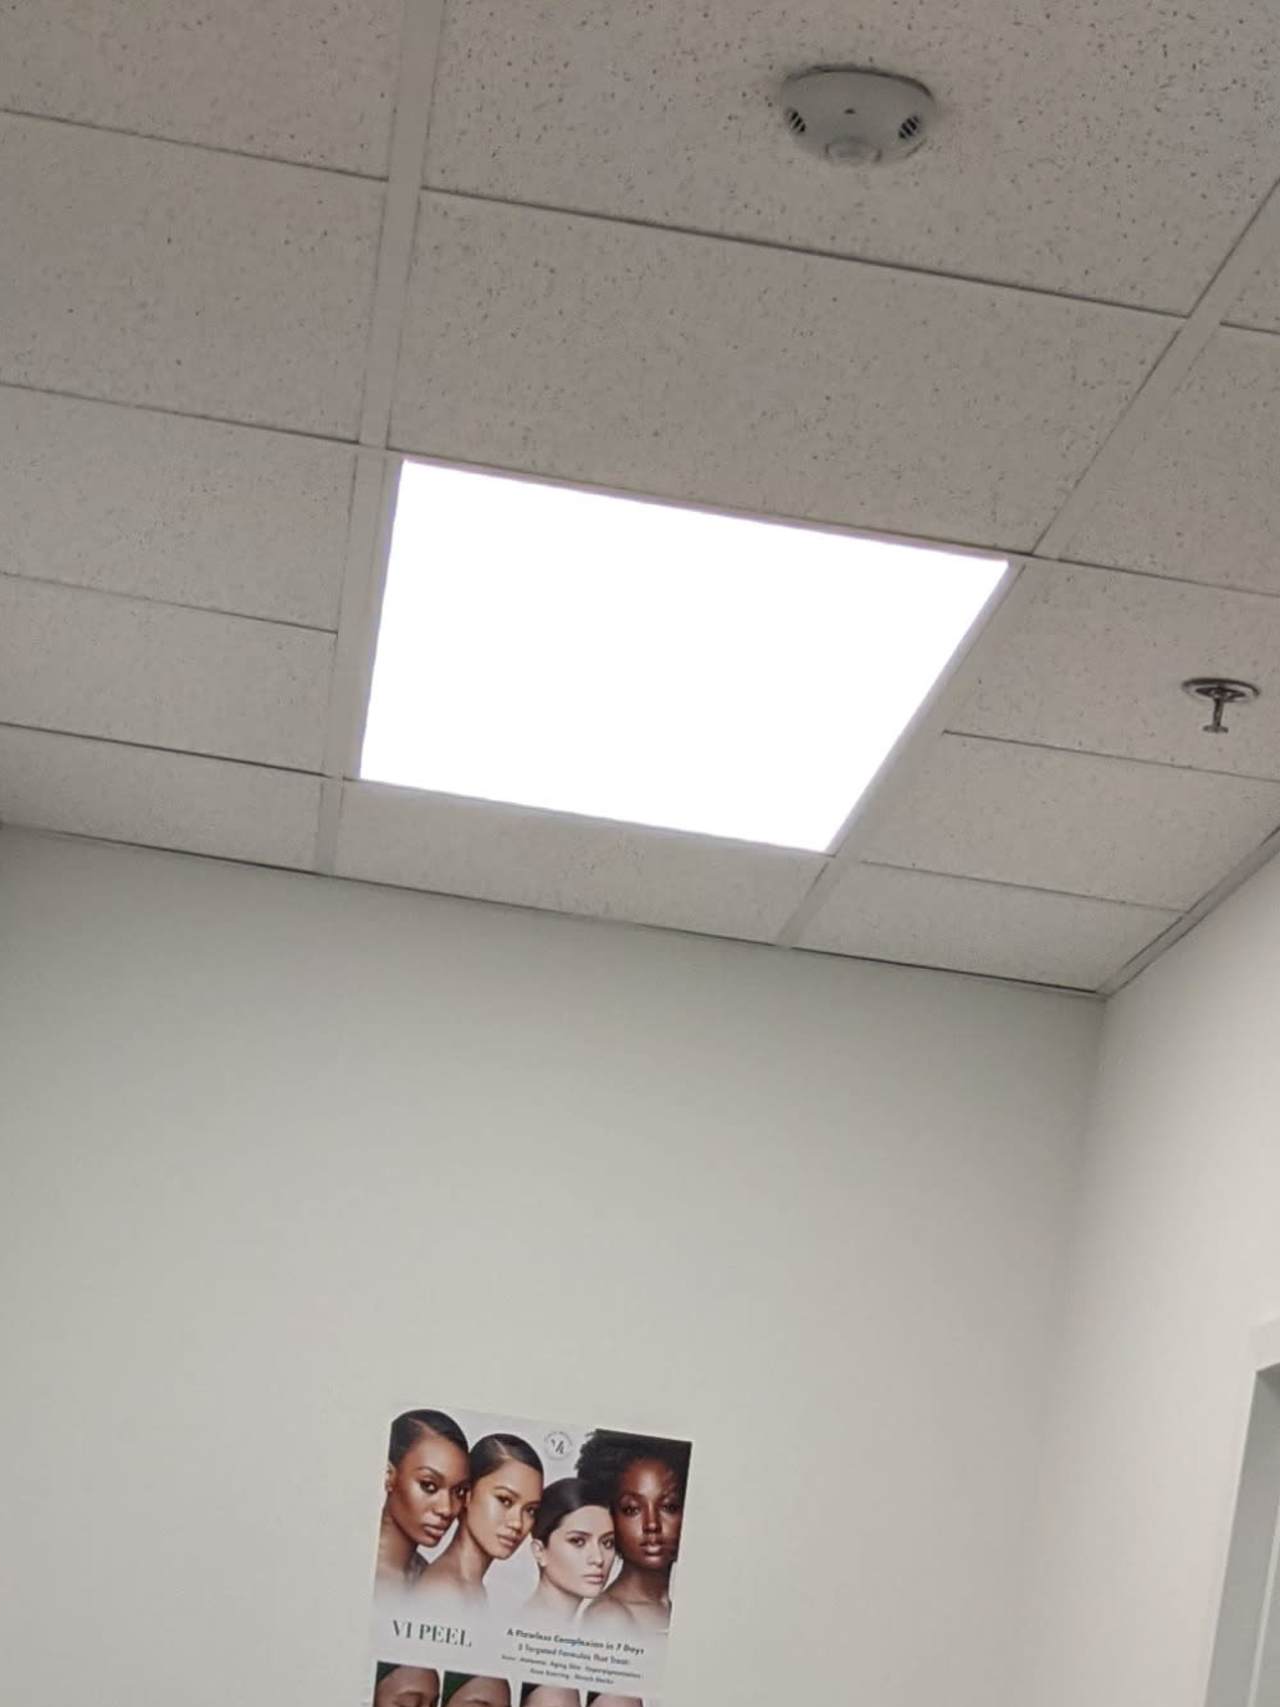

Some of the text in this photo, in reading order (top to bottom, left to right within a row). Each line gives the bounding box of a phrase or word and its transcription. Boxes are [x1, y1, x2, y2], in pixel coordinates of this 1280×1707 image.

[392, 1619, 472, 1649] VI PEEL
[507, 1627, 514, 1637] A
[515, 1628, 552, 1642] Flawless
[553, 1634, 604, 1648] Complexion
[606, 1641, 614, 1650] in
[623, 1643, 645, 1656] Days
